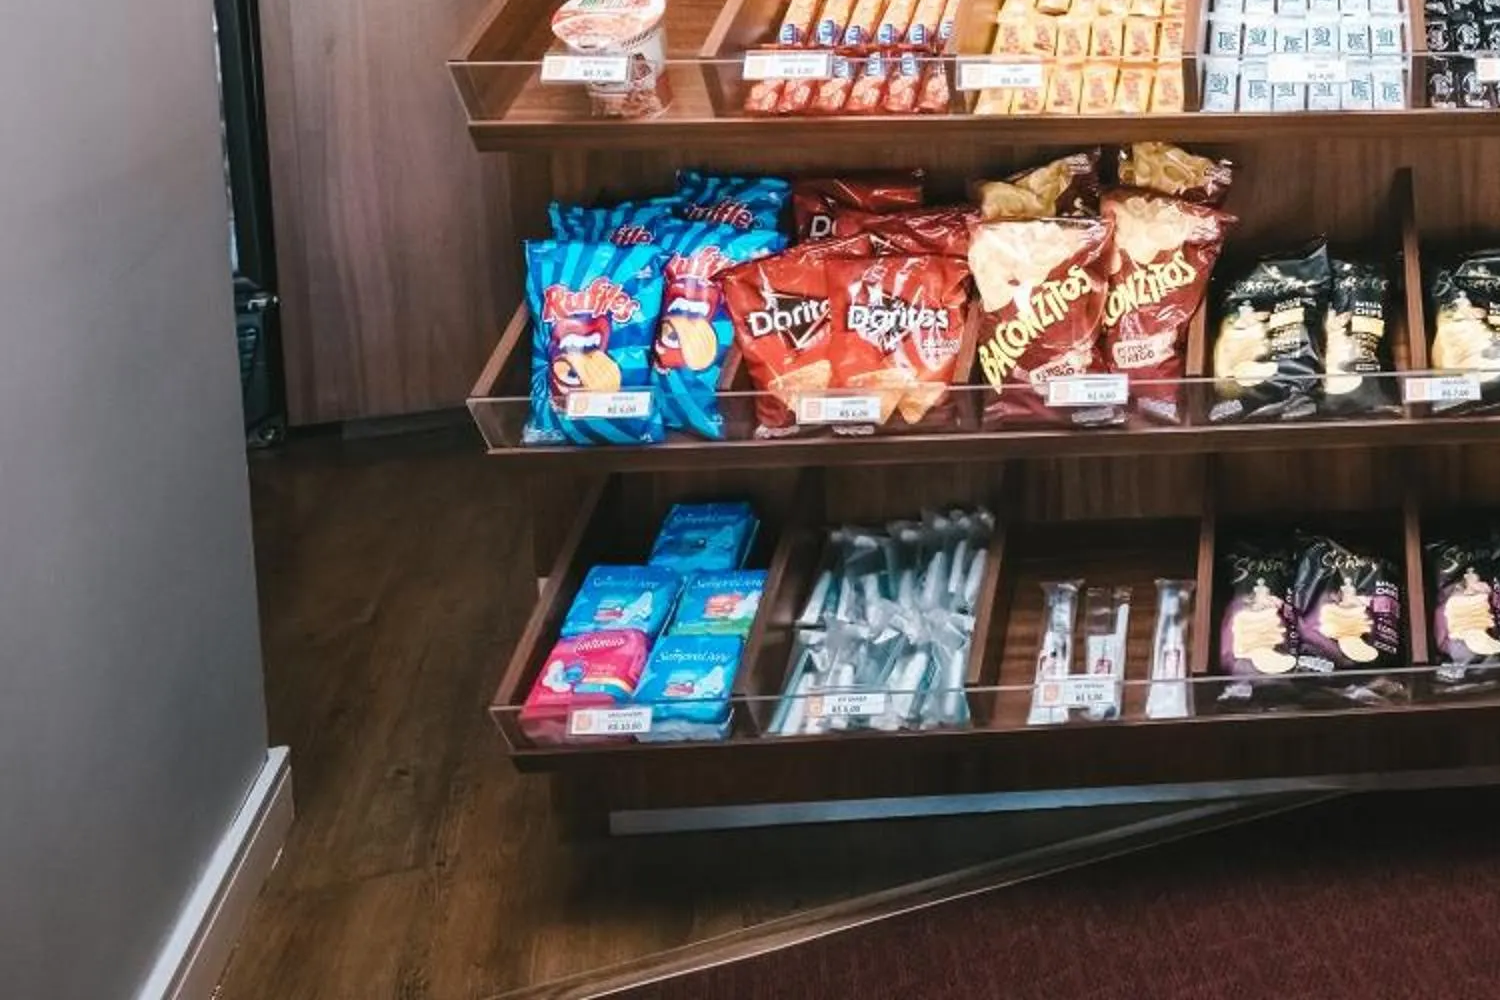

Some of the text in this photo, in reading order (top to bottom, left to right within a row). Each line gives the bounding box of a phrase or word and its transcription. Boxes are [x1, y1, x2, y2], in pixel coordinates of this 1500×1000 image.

[543, 277, 641, 324] Ruffles
[1103, 249, 1198, 327] ONZITOS
[847, 302, 949, 332] Doritos
